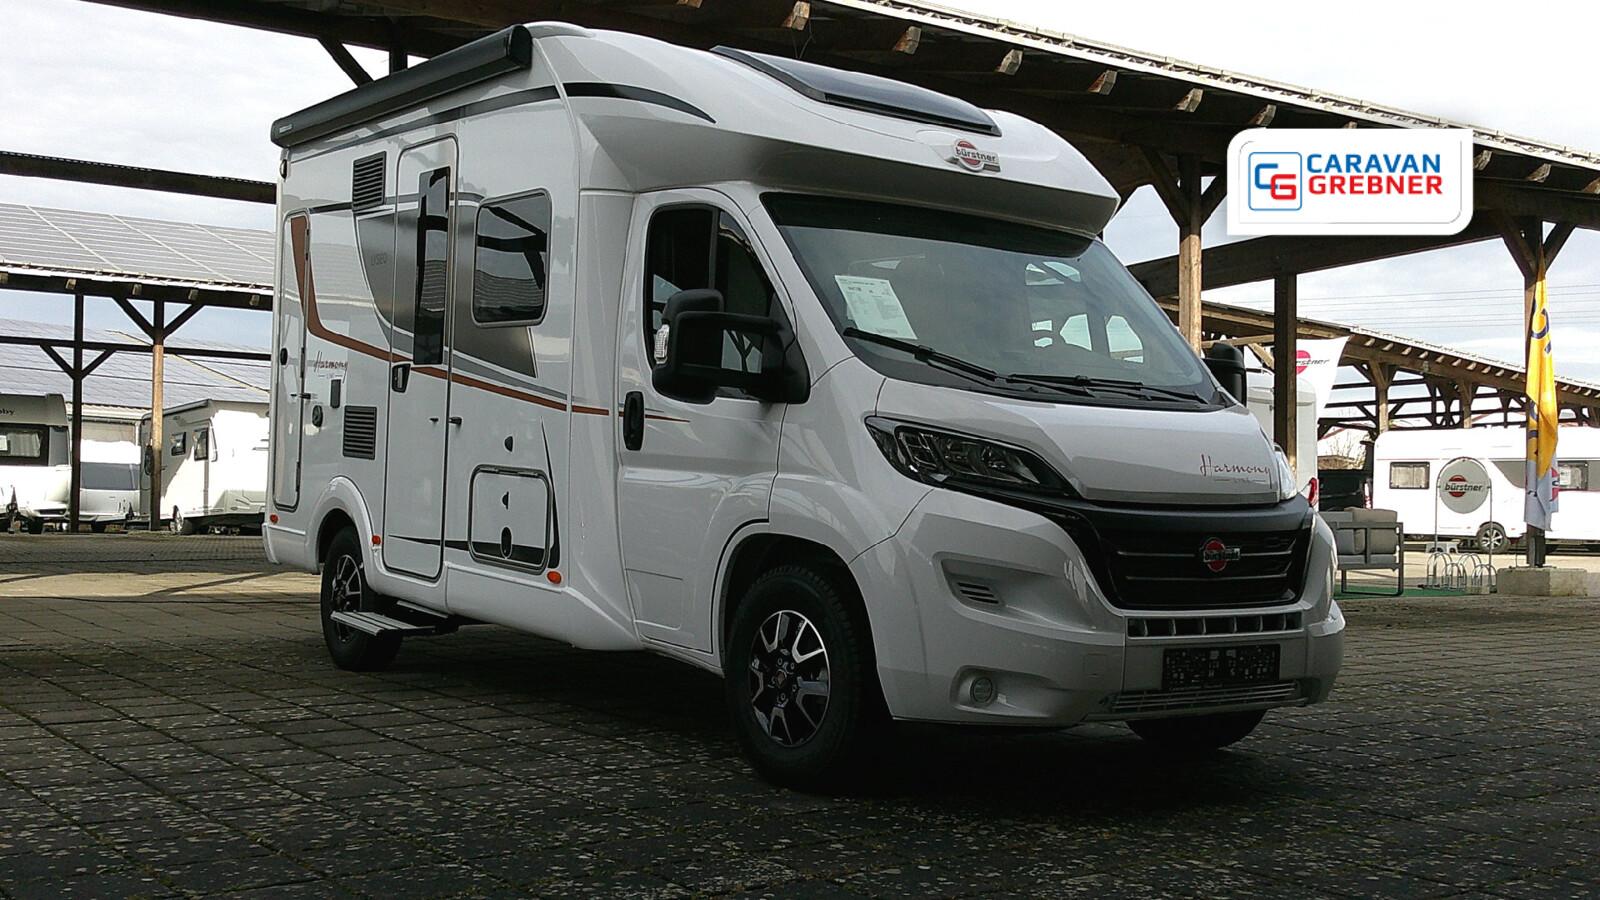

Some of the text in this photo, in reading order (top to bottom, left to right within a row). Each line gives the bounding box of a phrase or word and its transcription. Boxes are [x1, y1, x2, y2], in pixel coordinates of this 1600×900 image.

[955, 146, 996, 162] bürstner
[313, 350, 349, 384] Harmony
[1199, 453, 1273, 490] Harmony
[1445, 482, 1483, 491] bürstner
